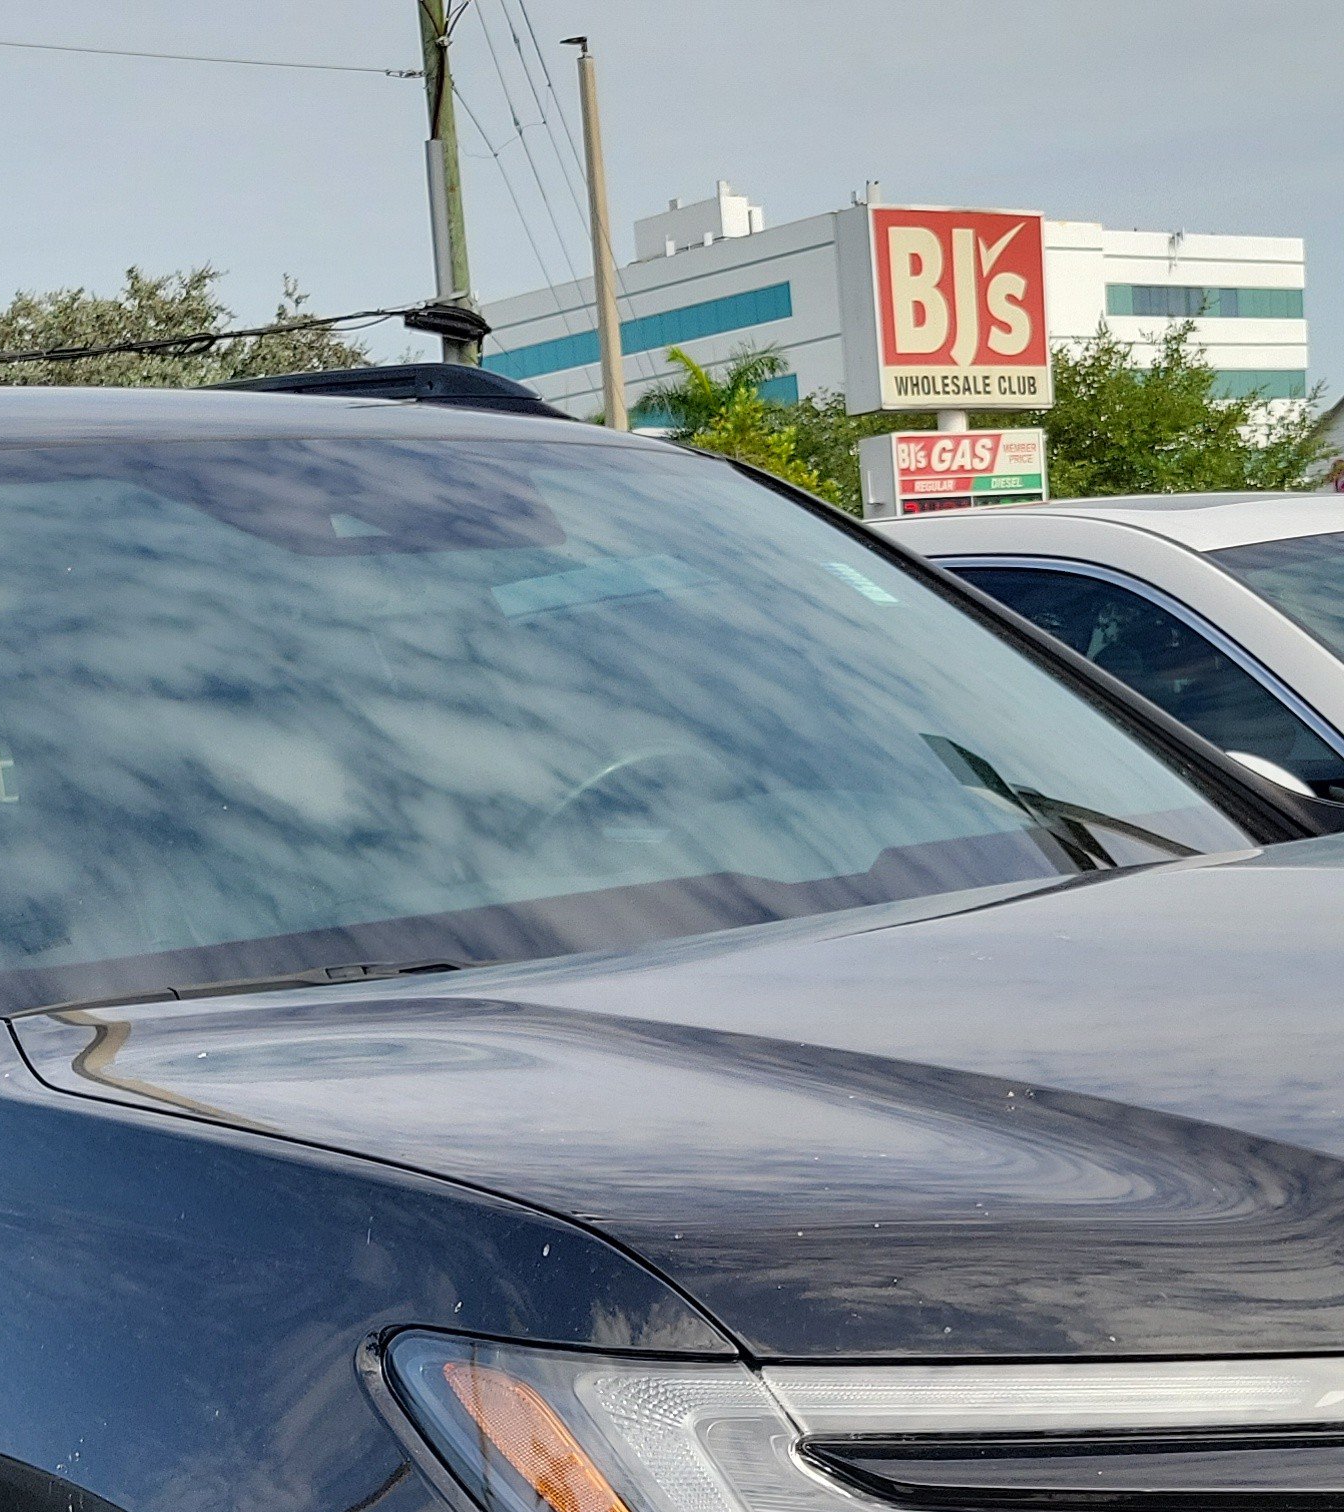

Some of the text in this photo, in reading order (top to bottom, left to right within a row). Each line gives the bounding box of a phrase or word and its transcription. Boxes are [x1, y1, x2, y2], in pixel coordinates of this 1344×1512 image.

[887, 222, 1033, 367] BJ's
[894, 375, 1037, 396] WHOLESALE CLUB
[930, 438, 993, 472] GAS
[914, 480, 954, 492] REGULAR
[991, 477, 1024, 489] DIESEL
